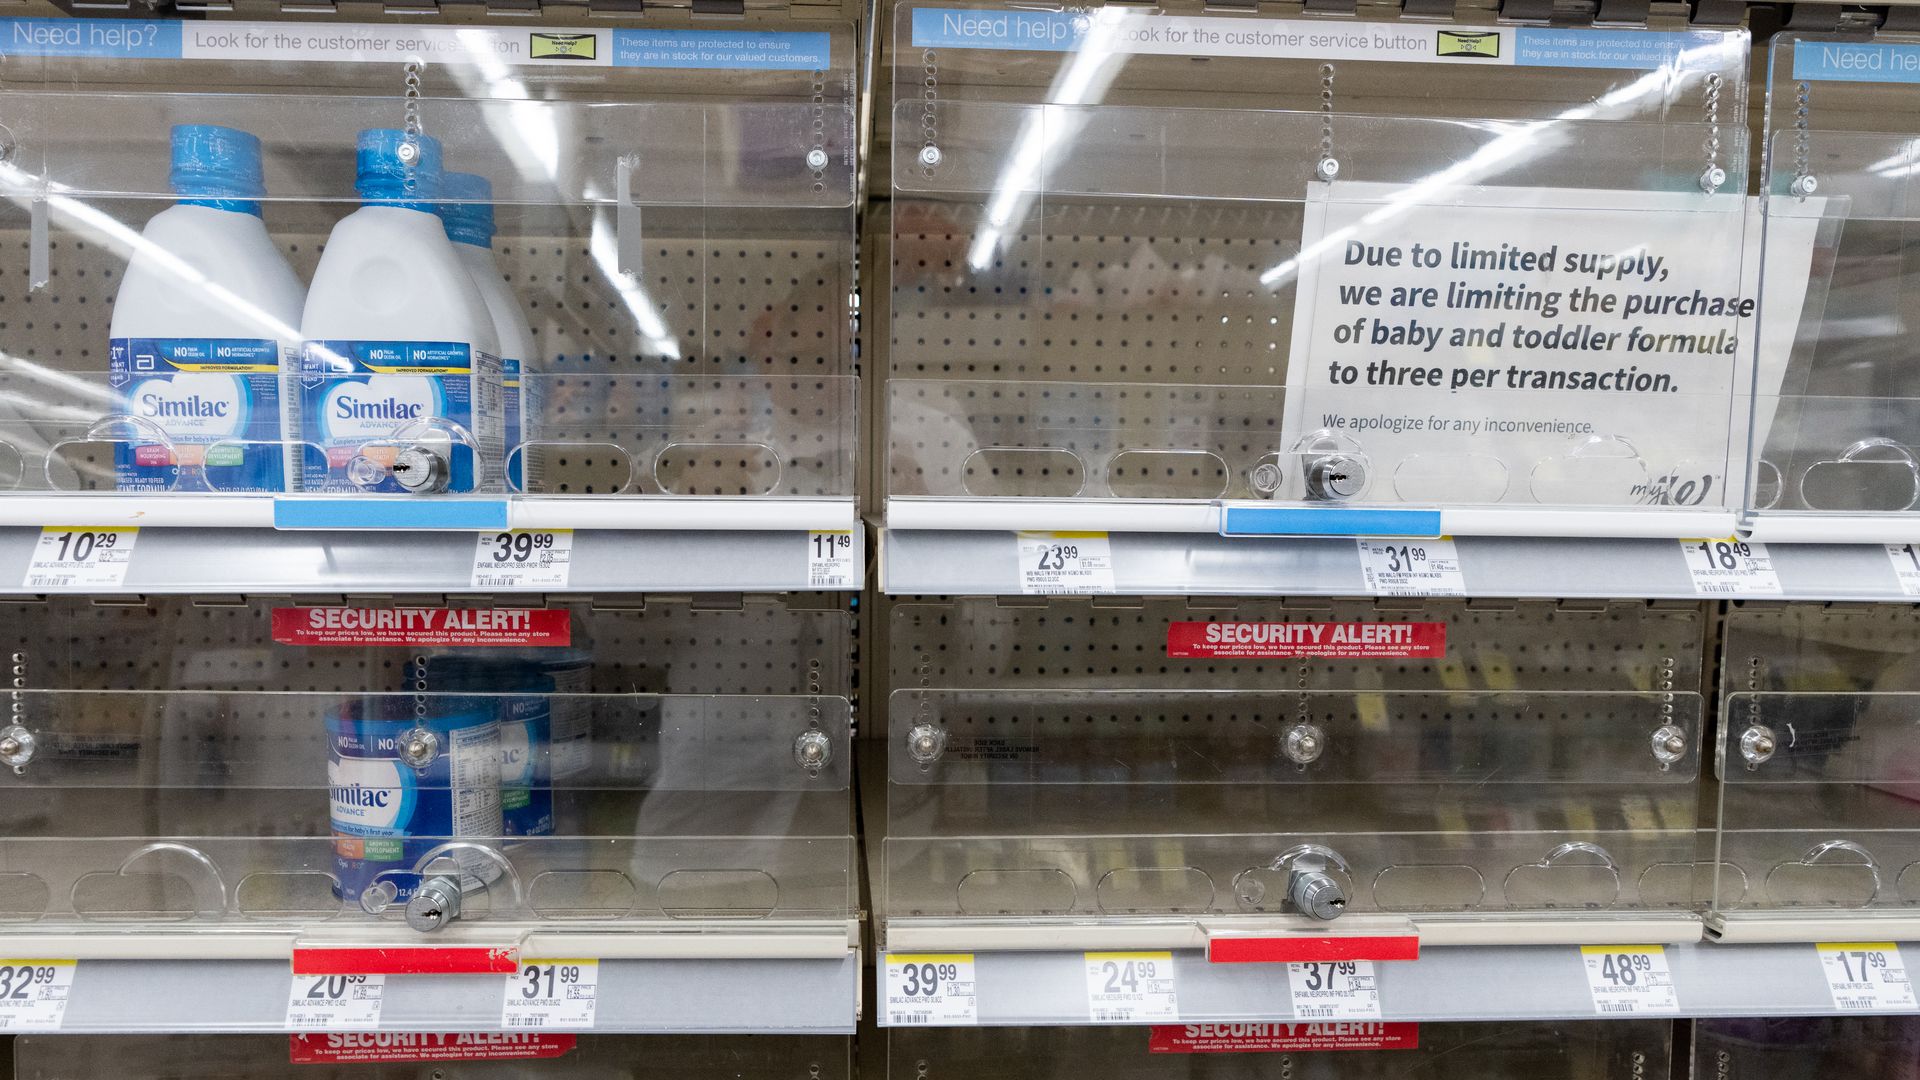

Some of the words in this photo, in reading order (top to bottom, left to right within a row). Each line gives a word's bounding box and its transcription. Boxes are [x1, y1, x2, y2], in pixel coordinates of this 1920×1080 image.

[943, 14, 1007, 36] Need
[14, 22, 80, 44] Need
[90, 24, 157, 51] help?
[196, 32, 239, 47] Look
[245, 33, 268, 48] for
[274, 34, 301, 48] the
[308, 35, 390, 50] customer
[620, 38, 649, 47] These
[652, 38, 678, 47] items
[698, 40, 744, 50] protected
[1121, 27, 1160, 42] ook
[1164, 27, 1188, 42] for
[1193, 28, 1219, 43] the
[1225, 31, 1304, 46] customer
[1310, 33, 1368, 48] service
[1374, 34, 1427, 50] button
[1524, 36, 1550, 45] These
[1553, 38, 1577, 46] items
[1596, 39, 1640, 49] protected
[1643, 40, 1651, 48] to
[620, 50, 640, 61] they
[643, 52, 658, 60] are
[661, 51, 669, 60] in
[672, 52, 698, 60] stock
[701, 52, 714, 60] for
[735, 53, 765, 61] valued
[768, 54, 821, 63] customers.
[1522, 49, 1541, 60] they
[1560, 50, 1569, 58] in
[1571, 50, 1596, 59] stock
[1599, 51, 1612, 59] for
[1631, 53, 1661, 61] valued
[1823, 47, 1882, 70] Need
[1344, 240, 1402, 265] Due
[1412, 242, 1442, 268] to
[1450, 243, 1557, 272] limited
[1564, 247, 1669, 281] supply,
[1339, 284, 1382, 305] we
[1391, 286, 1439, 308] are
[1447, 283, 1562, 317] limiting
[1569, 286, 1617, 313] the
[1623, 291, 1755, 319] purchase
[1334, 319, 1366, 344] of
[1371, 319, 1443, 352] baby
[1450, 322, 1504, 349] and
[1512, 326, 1620, 351] toddler
[1627, 329, 1738, 355] formula
[174, 347, 187, 357] NO
[217, 347, 231, 357] NO
[370, 350, 383, 360] NO
[413, 350, 426, 360] NO
[1329, 360, 1359, 384] to
[1366, 362, 1443, 386] three
[1450, 369, 1500, 393] per
[1507, 365, 1678, 392] transaction.
[142, 393, 228, 417] Similac
[336, 396, 422, 419] Similac
[1322, 414, 1346, 430] We
[1349, 416, 1423, 433] apologize
[1428, 416, 1450, 431] for
[1453, 420, 1480, 435] any
[1484, 418, 1595, 433] inconvenience.
[310, 609, 436, 629] SECURITY
[444, 610, 530, 630] ALERT!
[1206, 624, 1325, 643] SECURITY
[1331, 624, 1412, 643] ALERT!
[338, 736, 348, 748] NO
[378, 738, 393, 750] NO
[336, 806, 365, 816] ADVANCE
[1185, 1024, 1298, 1037] SECURITY
